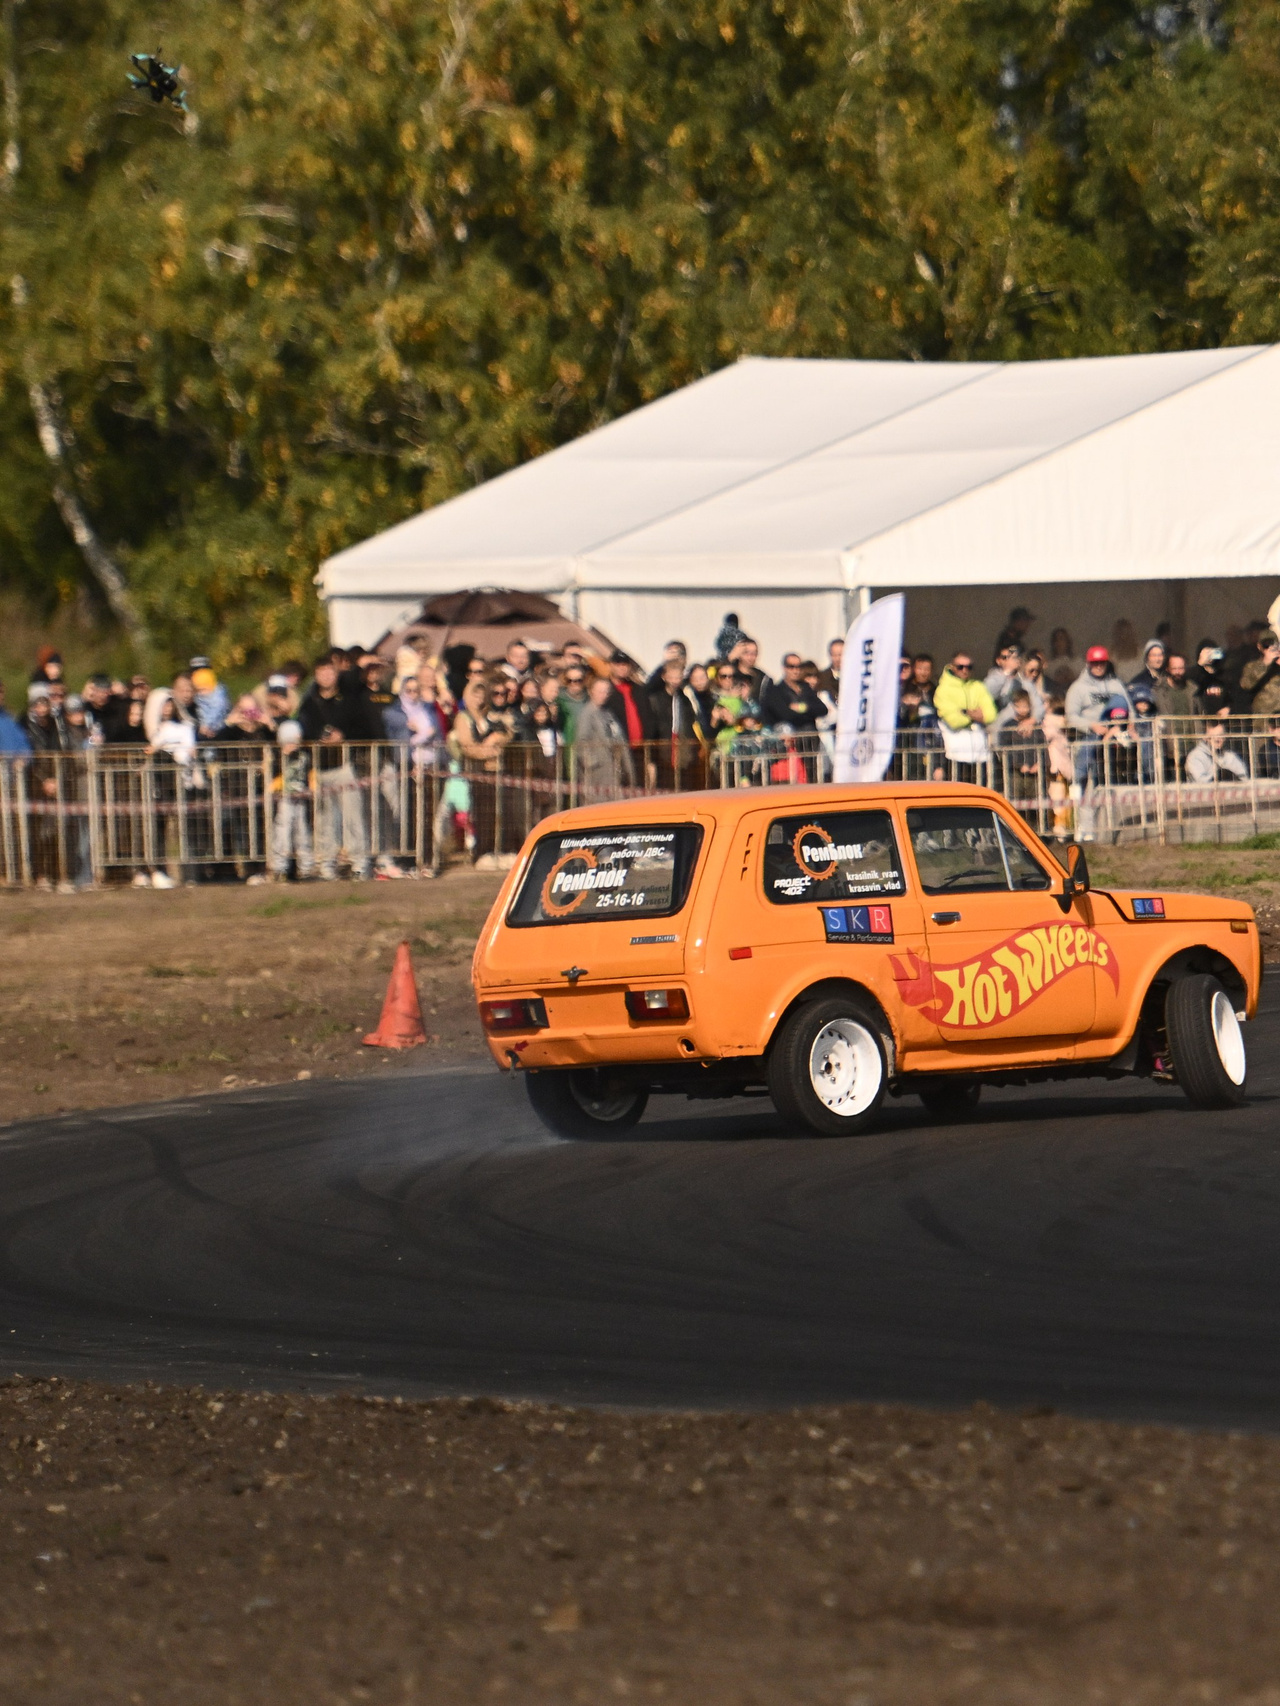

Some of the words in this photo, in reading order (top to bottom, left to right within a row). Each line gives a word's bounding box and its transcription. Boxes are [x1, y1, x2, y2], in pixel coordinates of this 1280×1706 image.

[560, 834, 674, 849] Шлифовально-расточные
[610, 849, 644, 860] работы
[643, 846, 665, 858] ДВС
[802, 843, 862, 862] РемБлок
[552, 869, 627, 893] РемБлок
[774, 876, 811, 888] PROJECT
[849, 881, 900, 892] krasavin_vlad
[781, 887, 805, 895] -402-
[596, 893, 644, 907] 25-16-16
[828, 909, 887, 930] SKR
[828, 933, 850, 941] Service
[851, 934, 856, 942] &
[934, 961, 1012, 1026] Hot
